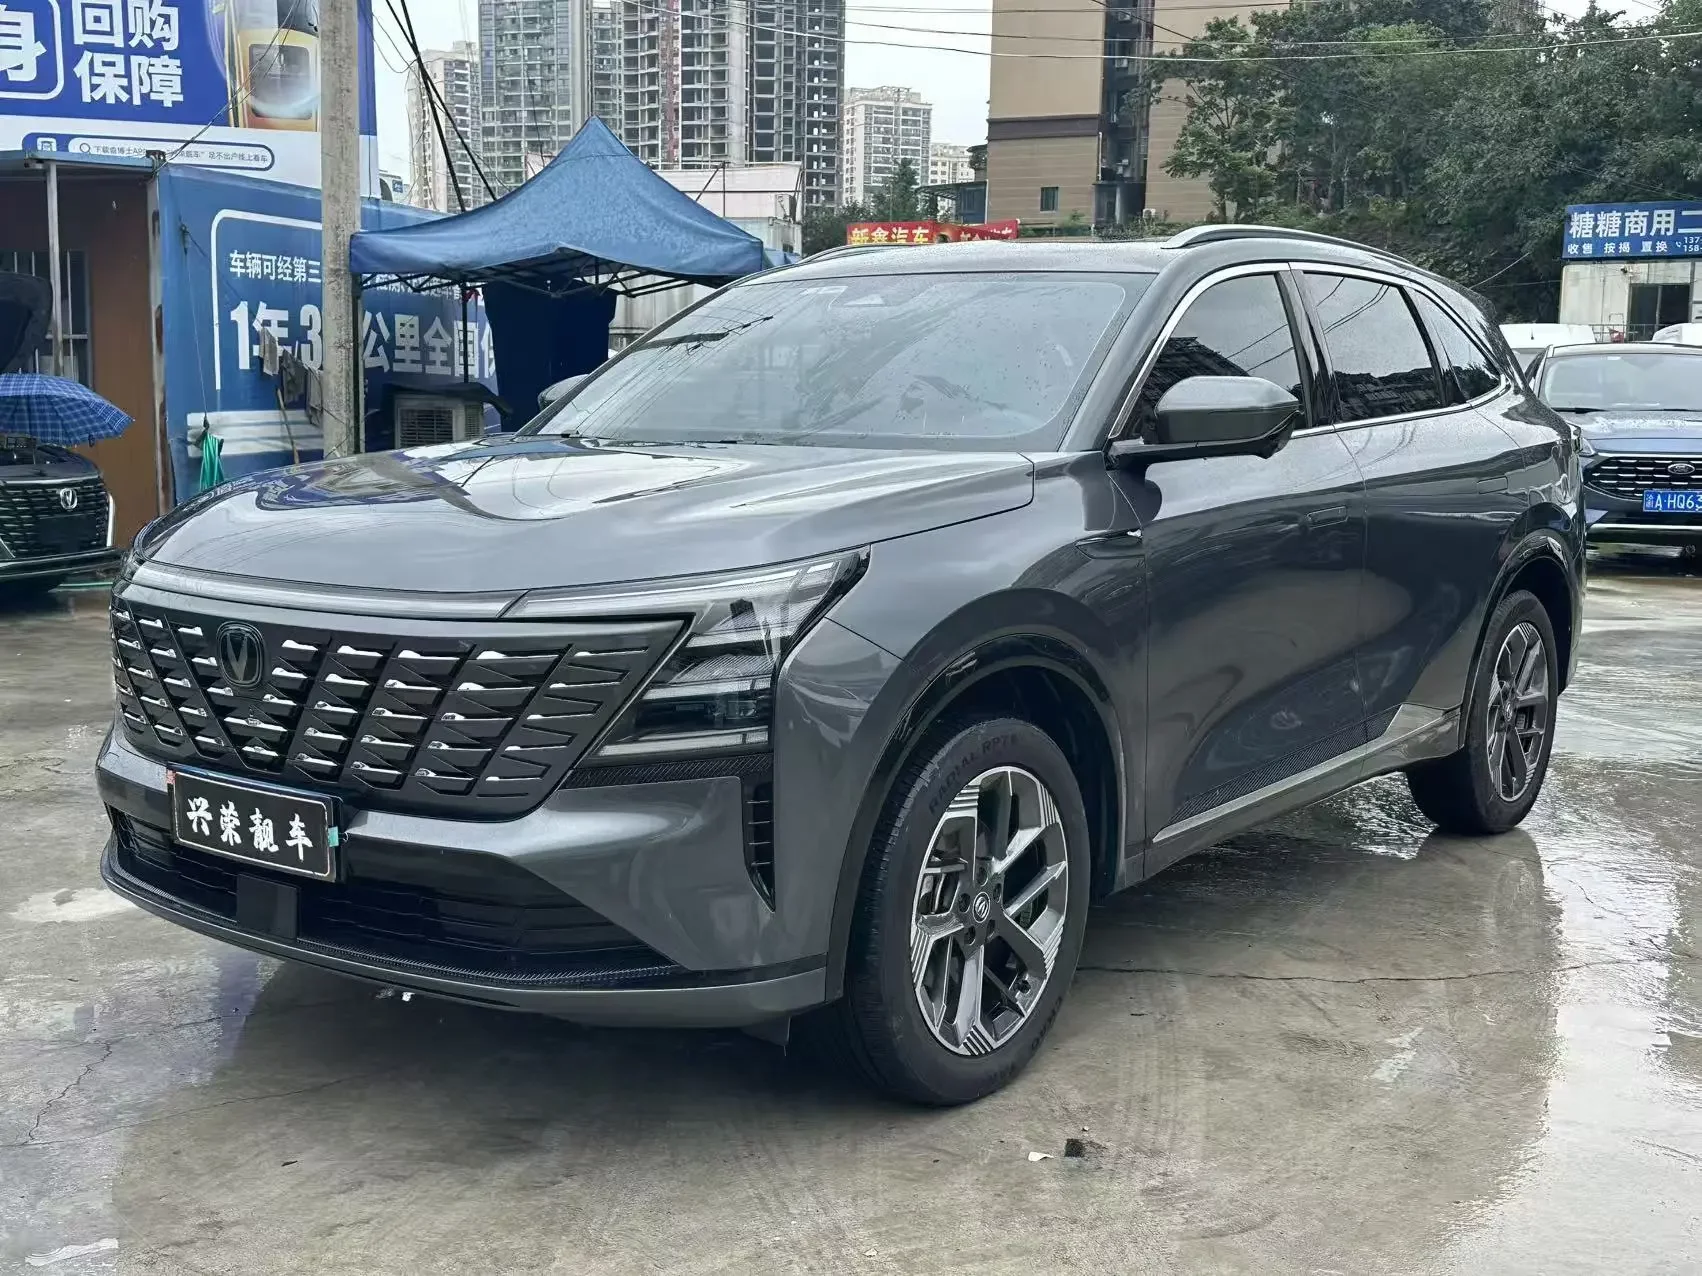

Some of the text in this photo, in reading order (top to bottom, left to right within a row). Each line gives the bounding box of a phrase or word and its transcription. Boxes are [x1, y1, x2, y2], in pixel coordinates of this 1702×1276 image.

[72, 0, 181, 51] 回购
[73, 51, 184, 107] 保障
[229, 249, 322, 283] 车辆可经第三
[1567, 240, 1668, 255] 收售 按揭 置换
[186, 796, 314, 862] 兴荣靓车
